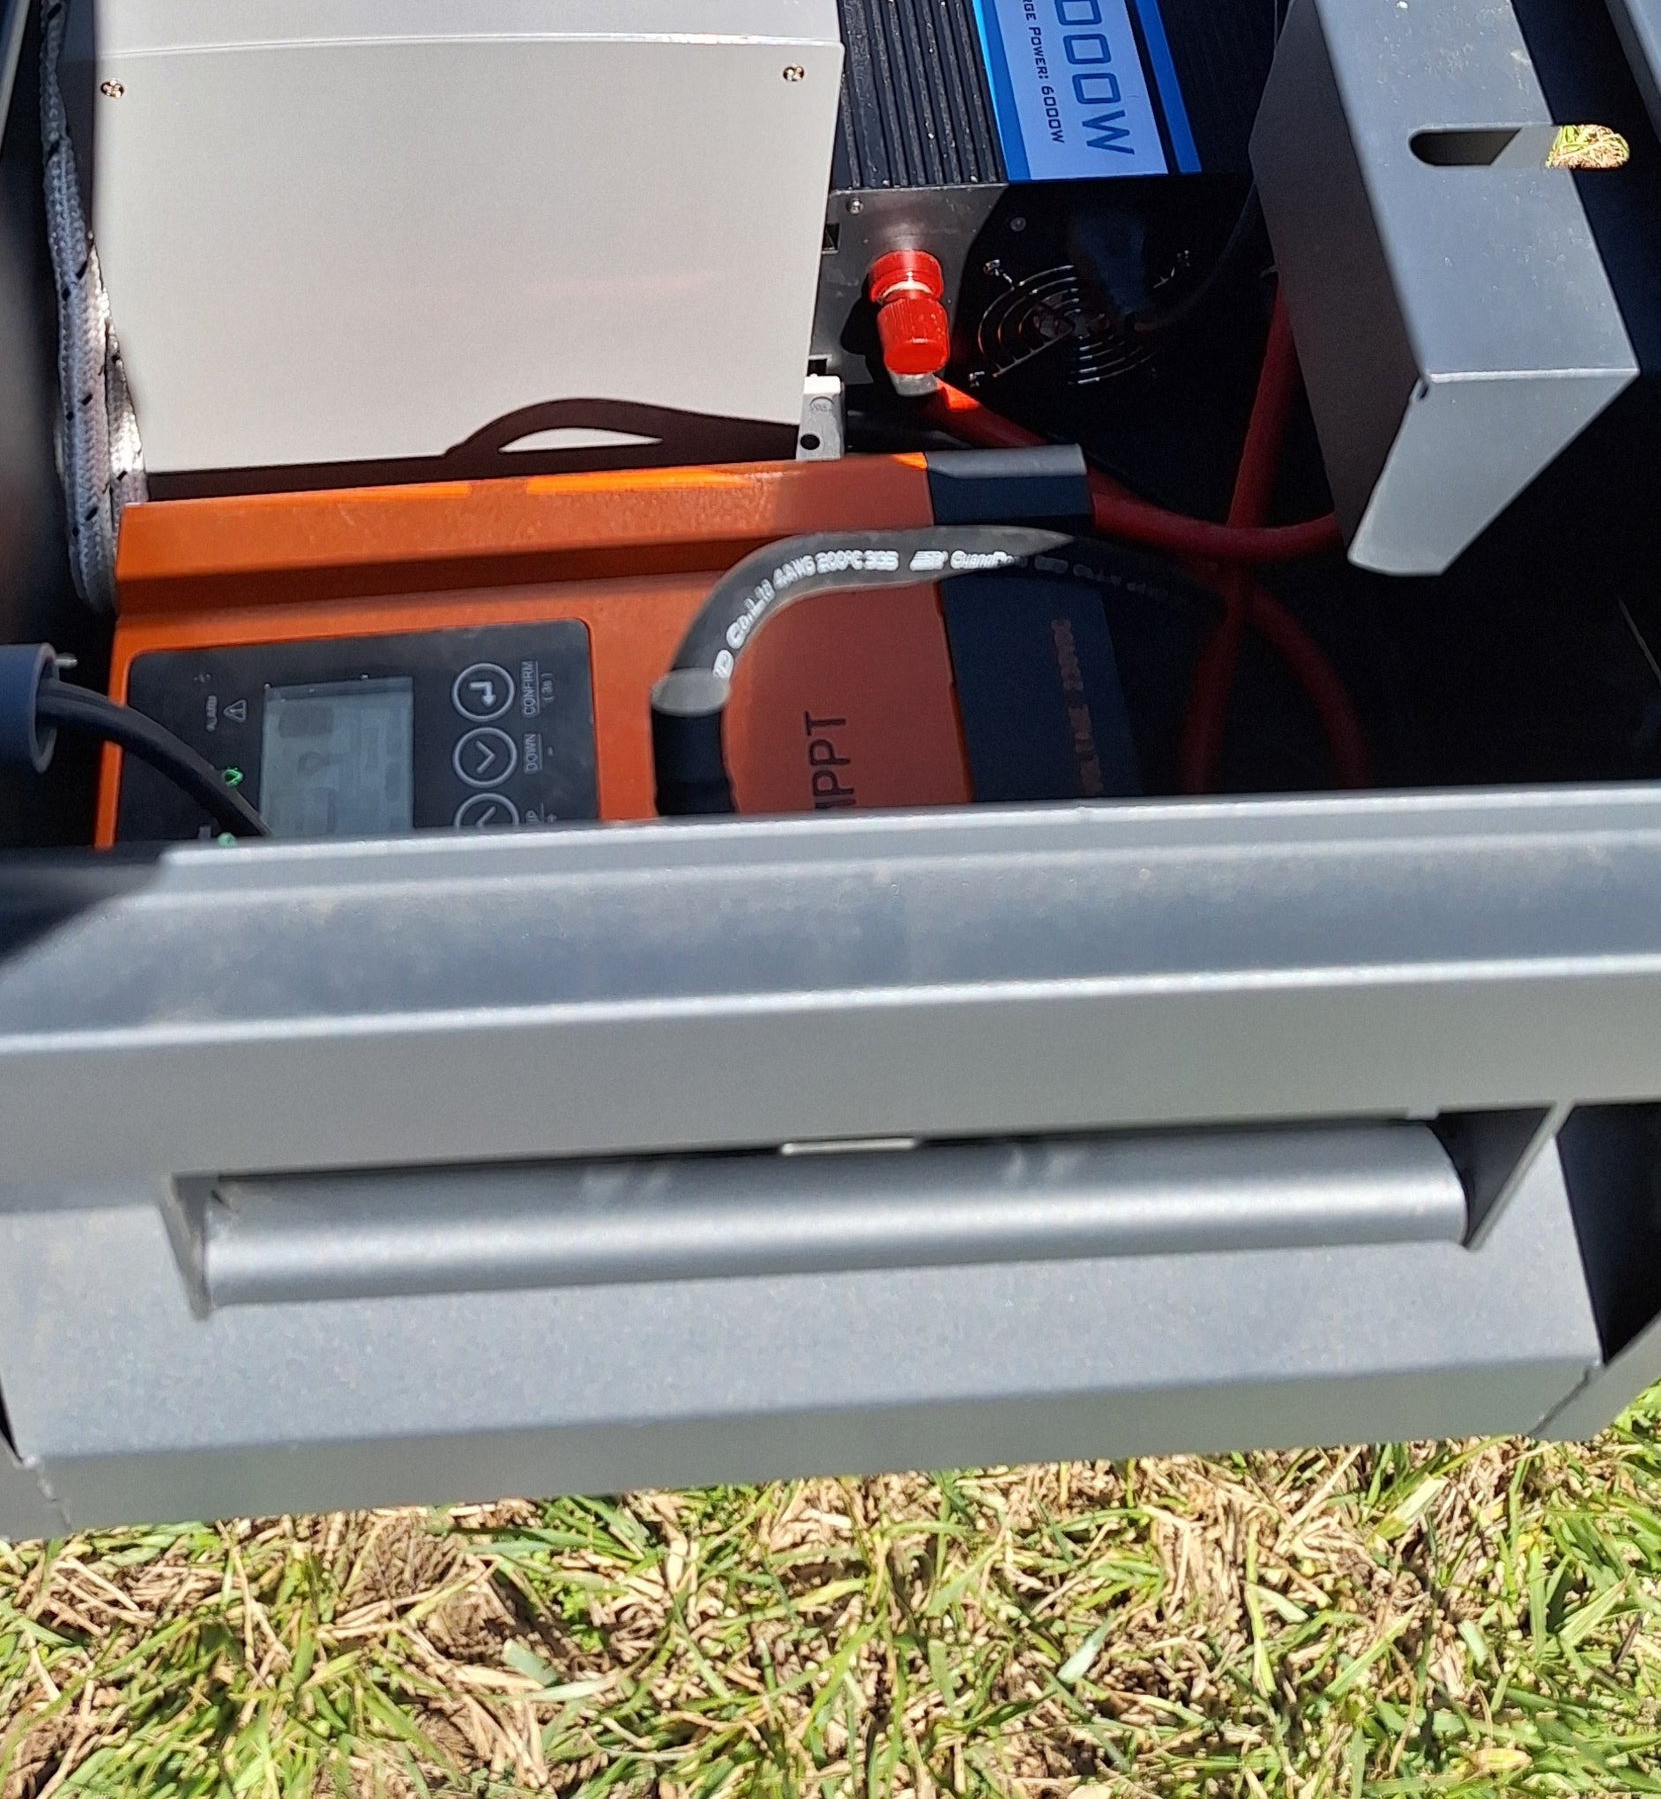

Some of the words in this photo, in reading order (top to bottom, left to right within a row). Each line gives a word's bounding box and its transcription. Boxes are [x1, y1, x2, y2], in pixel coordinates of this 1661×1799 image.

[1041, 84, 1064, 144] 6000W
[520, 660, 536, 716] CONFIRM
[524, 733, 538, 774] DOWN
